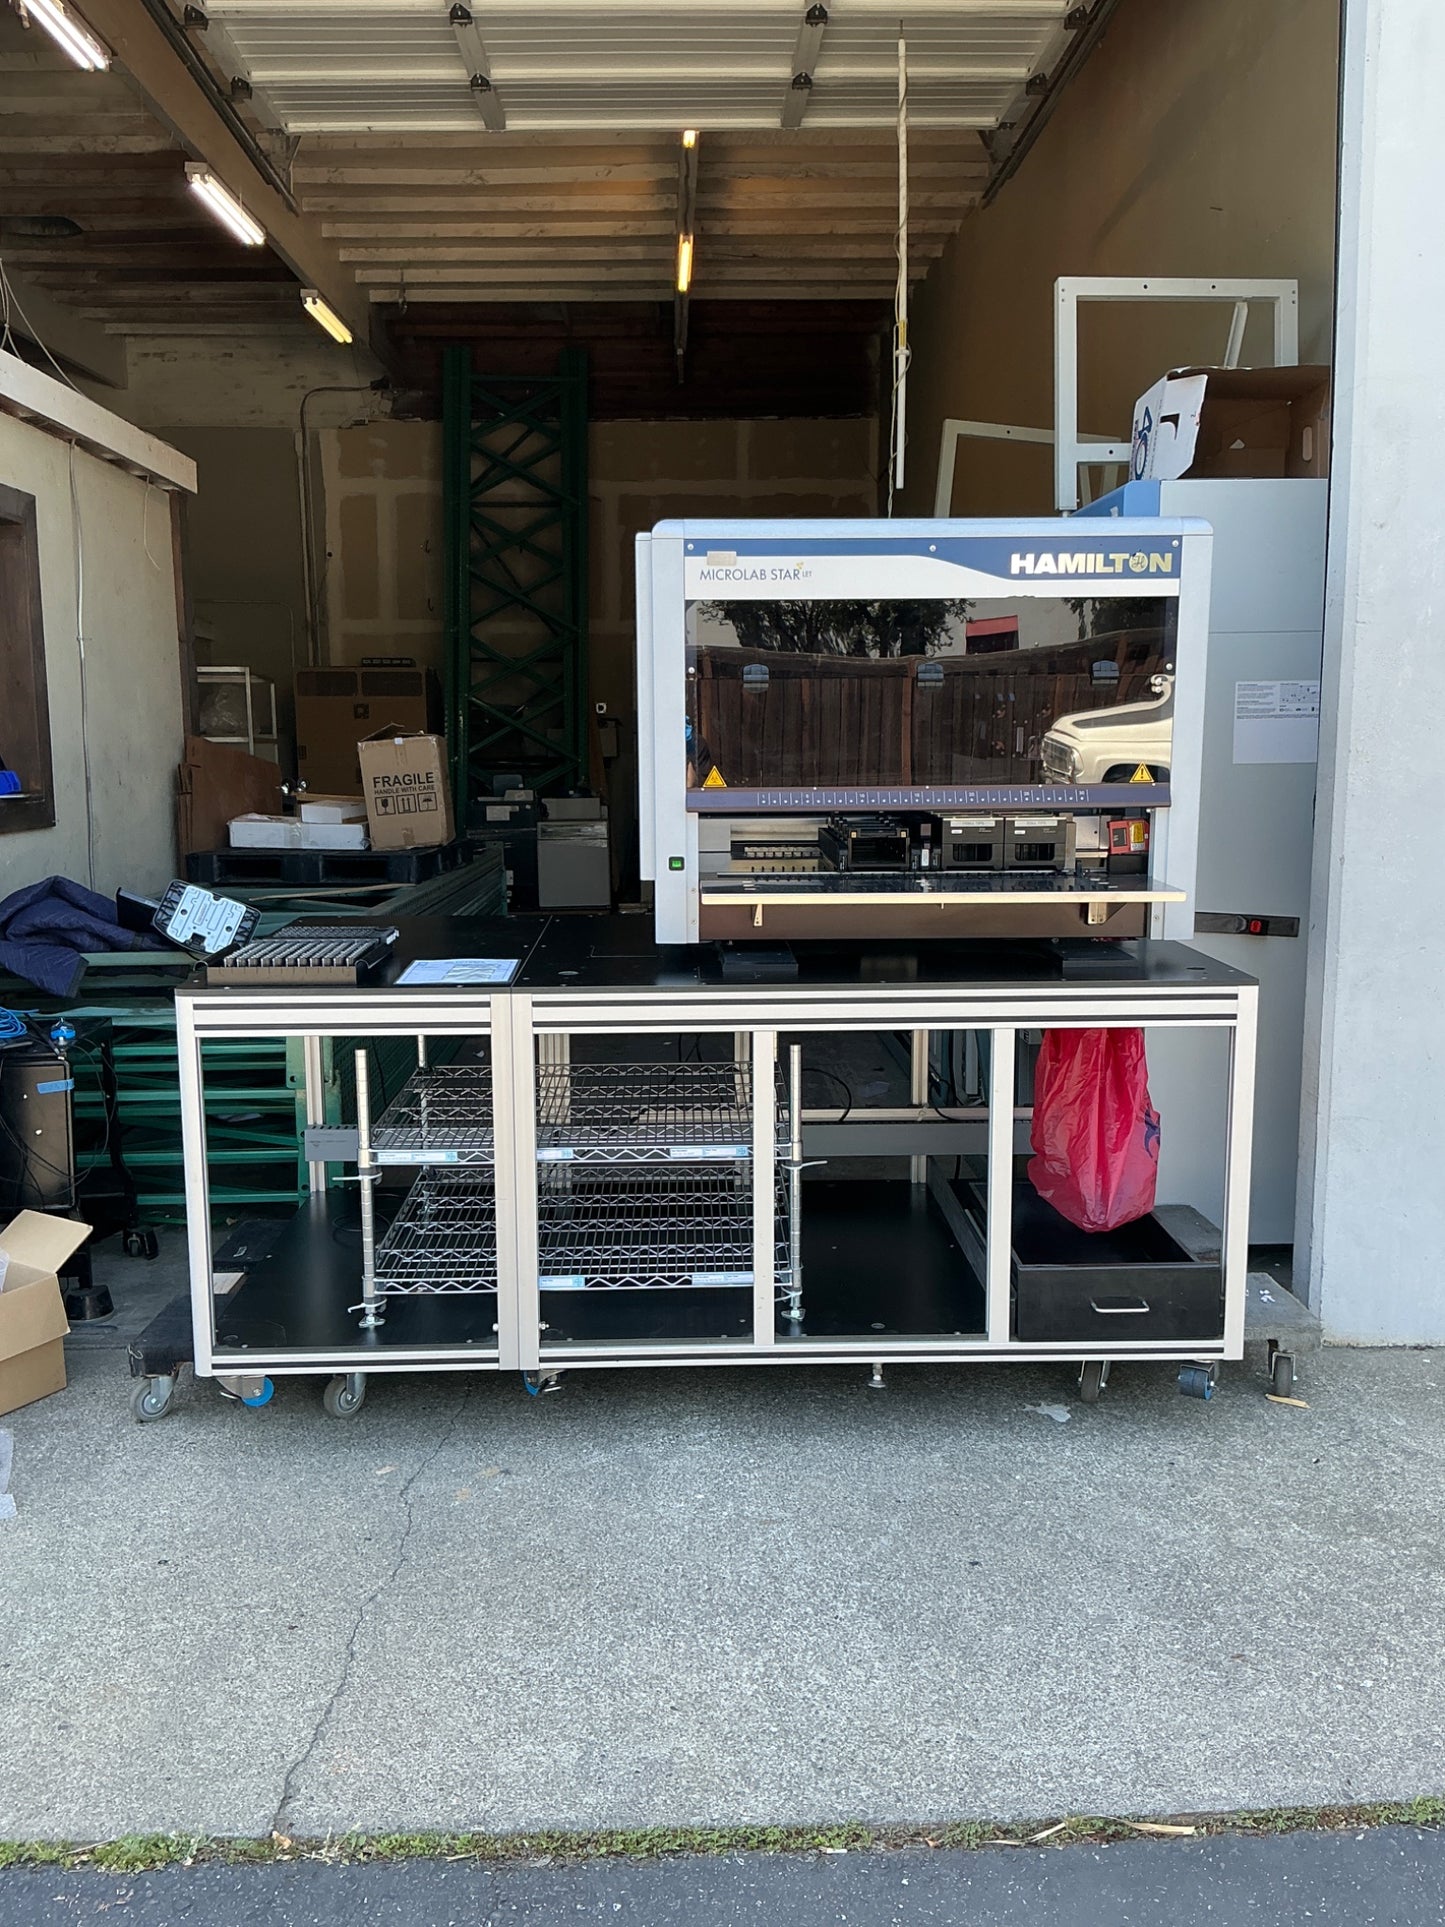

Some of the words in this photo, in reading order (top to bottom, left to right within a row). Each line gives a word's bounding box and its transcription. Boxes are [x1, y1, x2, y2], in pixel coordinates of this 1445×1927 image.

[1011, 552, 1172, 574] HAMILTON
[699, 568, 767, 581] MICROLAB
[373, 772, 434, 788] FRAGILE
[374, 787, 400, 795] HANDLE
[418, 784, 435, 792] CARE
